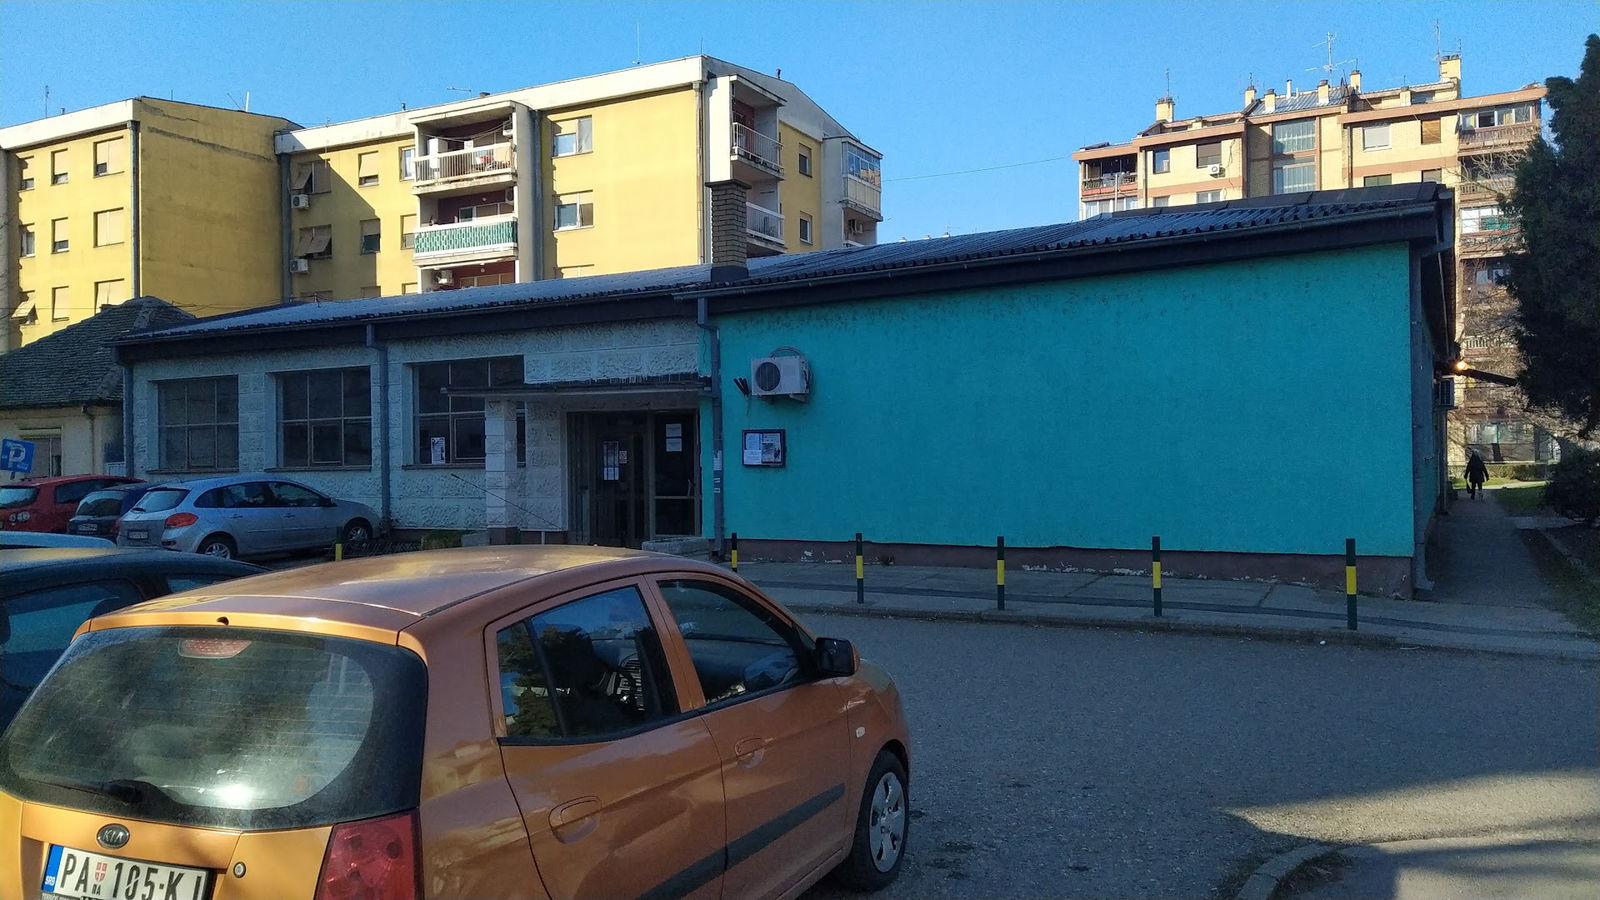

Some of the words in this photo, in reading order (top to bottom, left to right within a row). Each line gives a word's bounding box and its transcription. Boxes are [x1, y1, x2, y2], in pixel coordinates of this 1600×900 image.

[8, 445, 26, 469] P
[103, 830, 123, 842] KIA
[45, 875, 56, 886] SRB
[60, 853, 90, 893] PA
